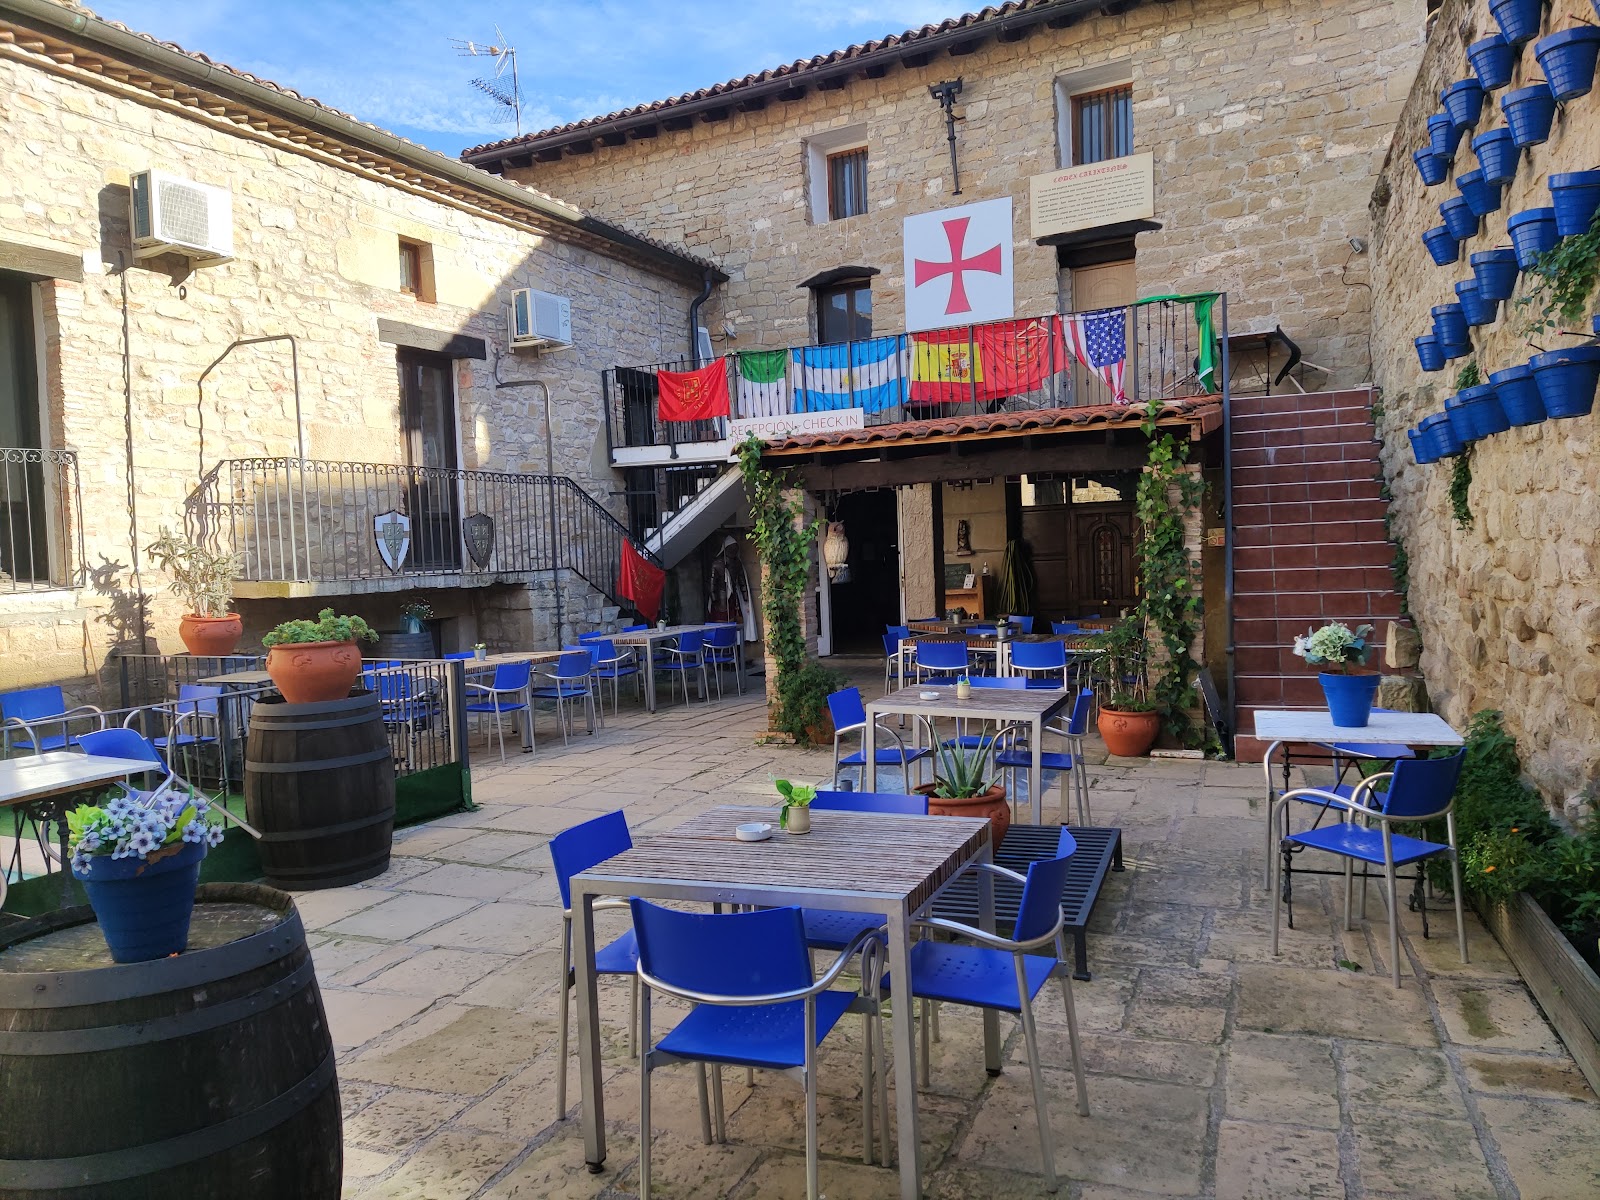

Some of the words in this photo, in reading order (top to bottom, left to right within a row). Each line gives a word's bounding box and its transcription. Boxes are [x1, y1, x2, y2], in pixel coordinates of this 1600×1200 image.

[1053, 173, 1078, 184] CODEX
[731, 419, 794, 436] RECEPCIÓN
[802, 416, 843, 430] CHECK
[846, 414, 858, 426] IN
